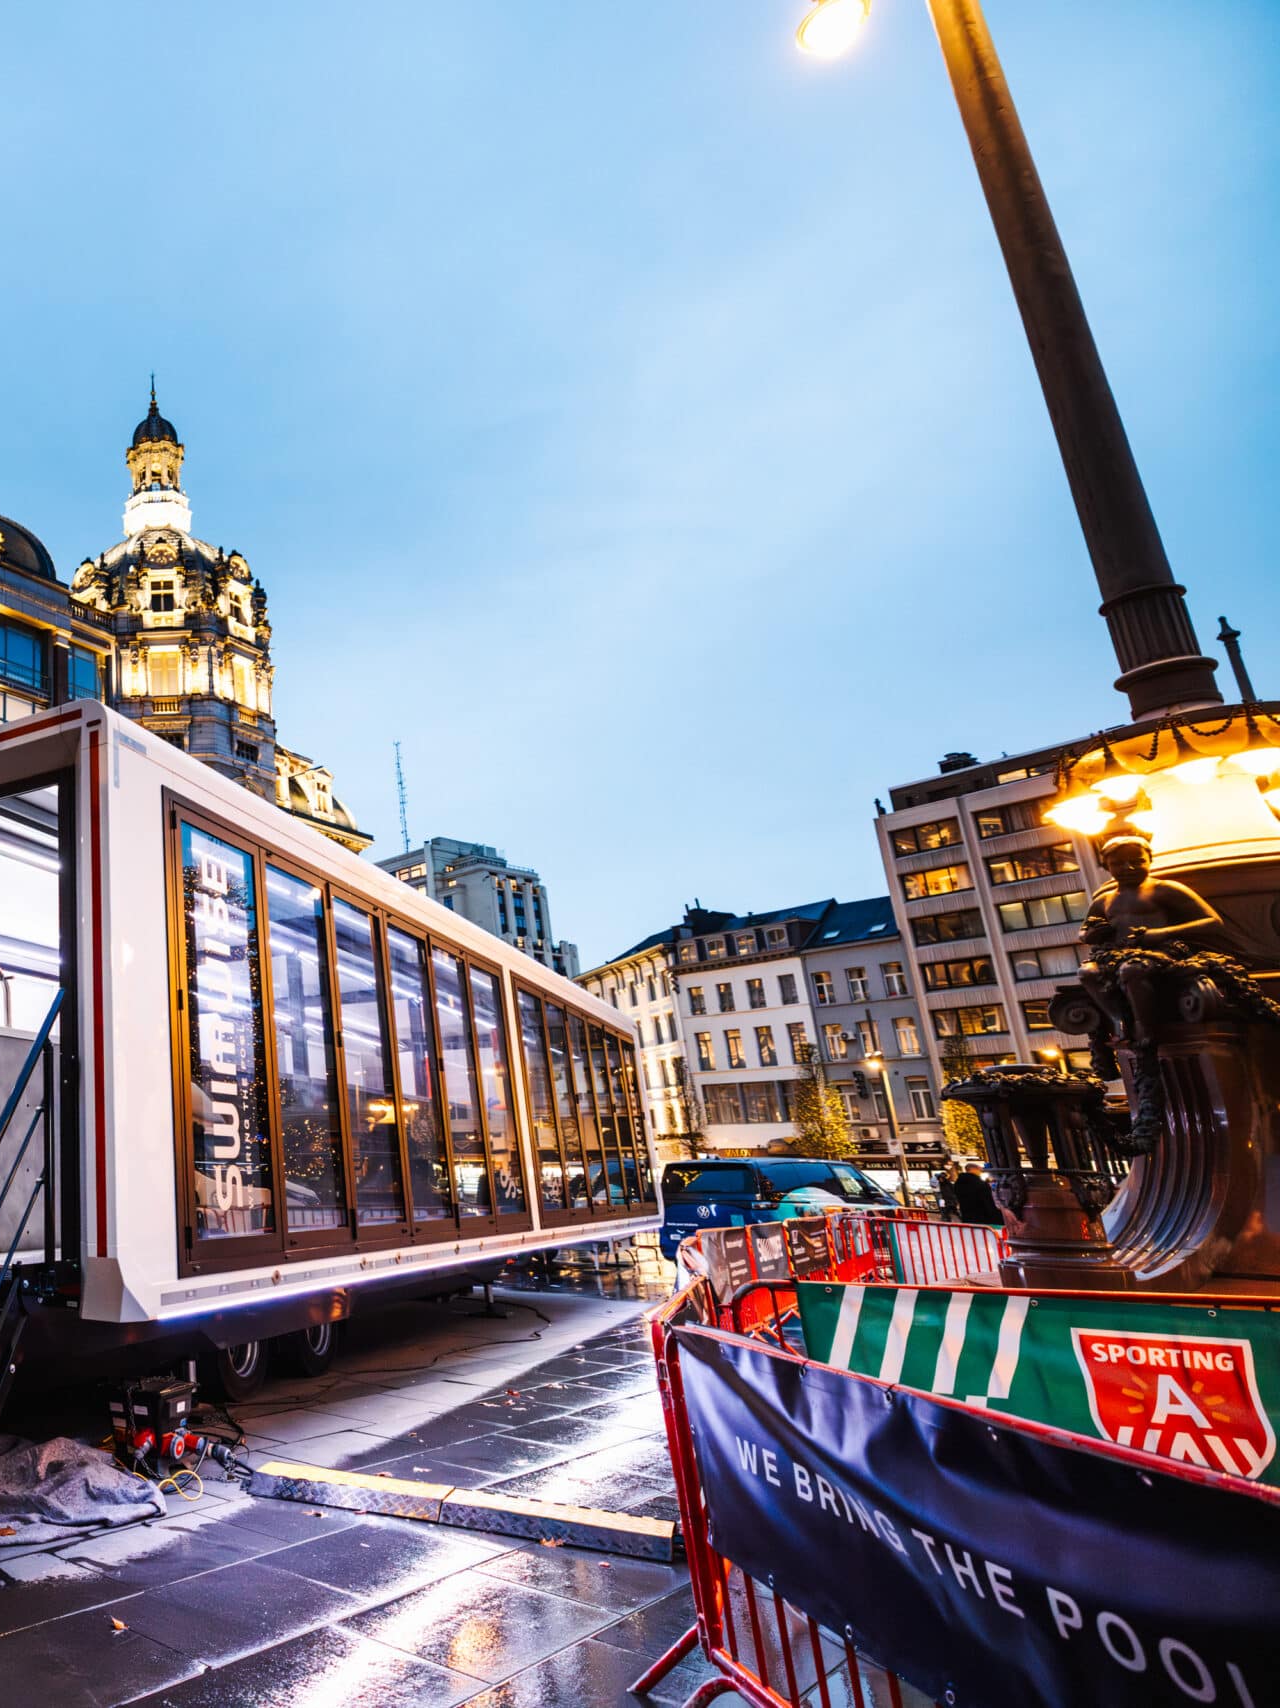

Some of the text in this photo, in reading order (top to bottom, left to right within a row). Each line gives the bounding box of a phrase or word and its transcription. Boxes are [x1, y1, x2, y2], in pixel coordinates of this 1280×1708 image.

[1091, 1343, 1235, 1372] SPORTING
[1151, 1374, 1213, 1429] A
[736, 1436, 781, 1487] WE
[793, 1462, 910, 1557] BRING
[911, 1528, 1025, 1619] THE
